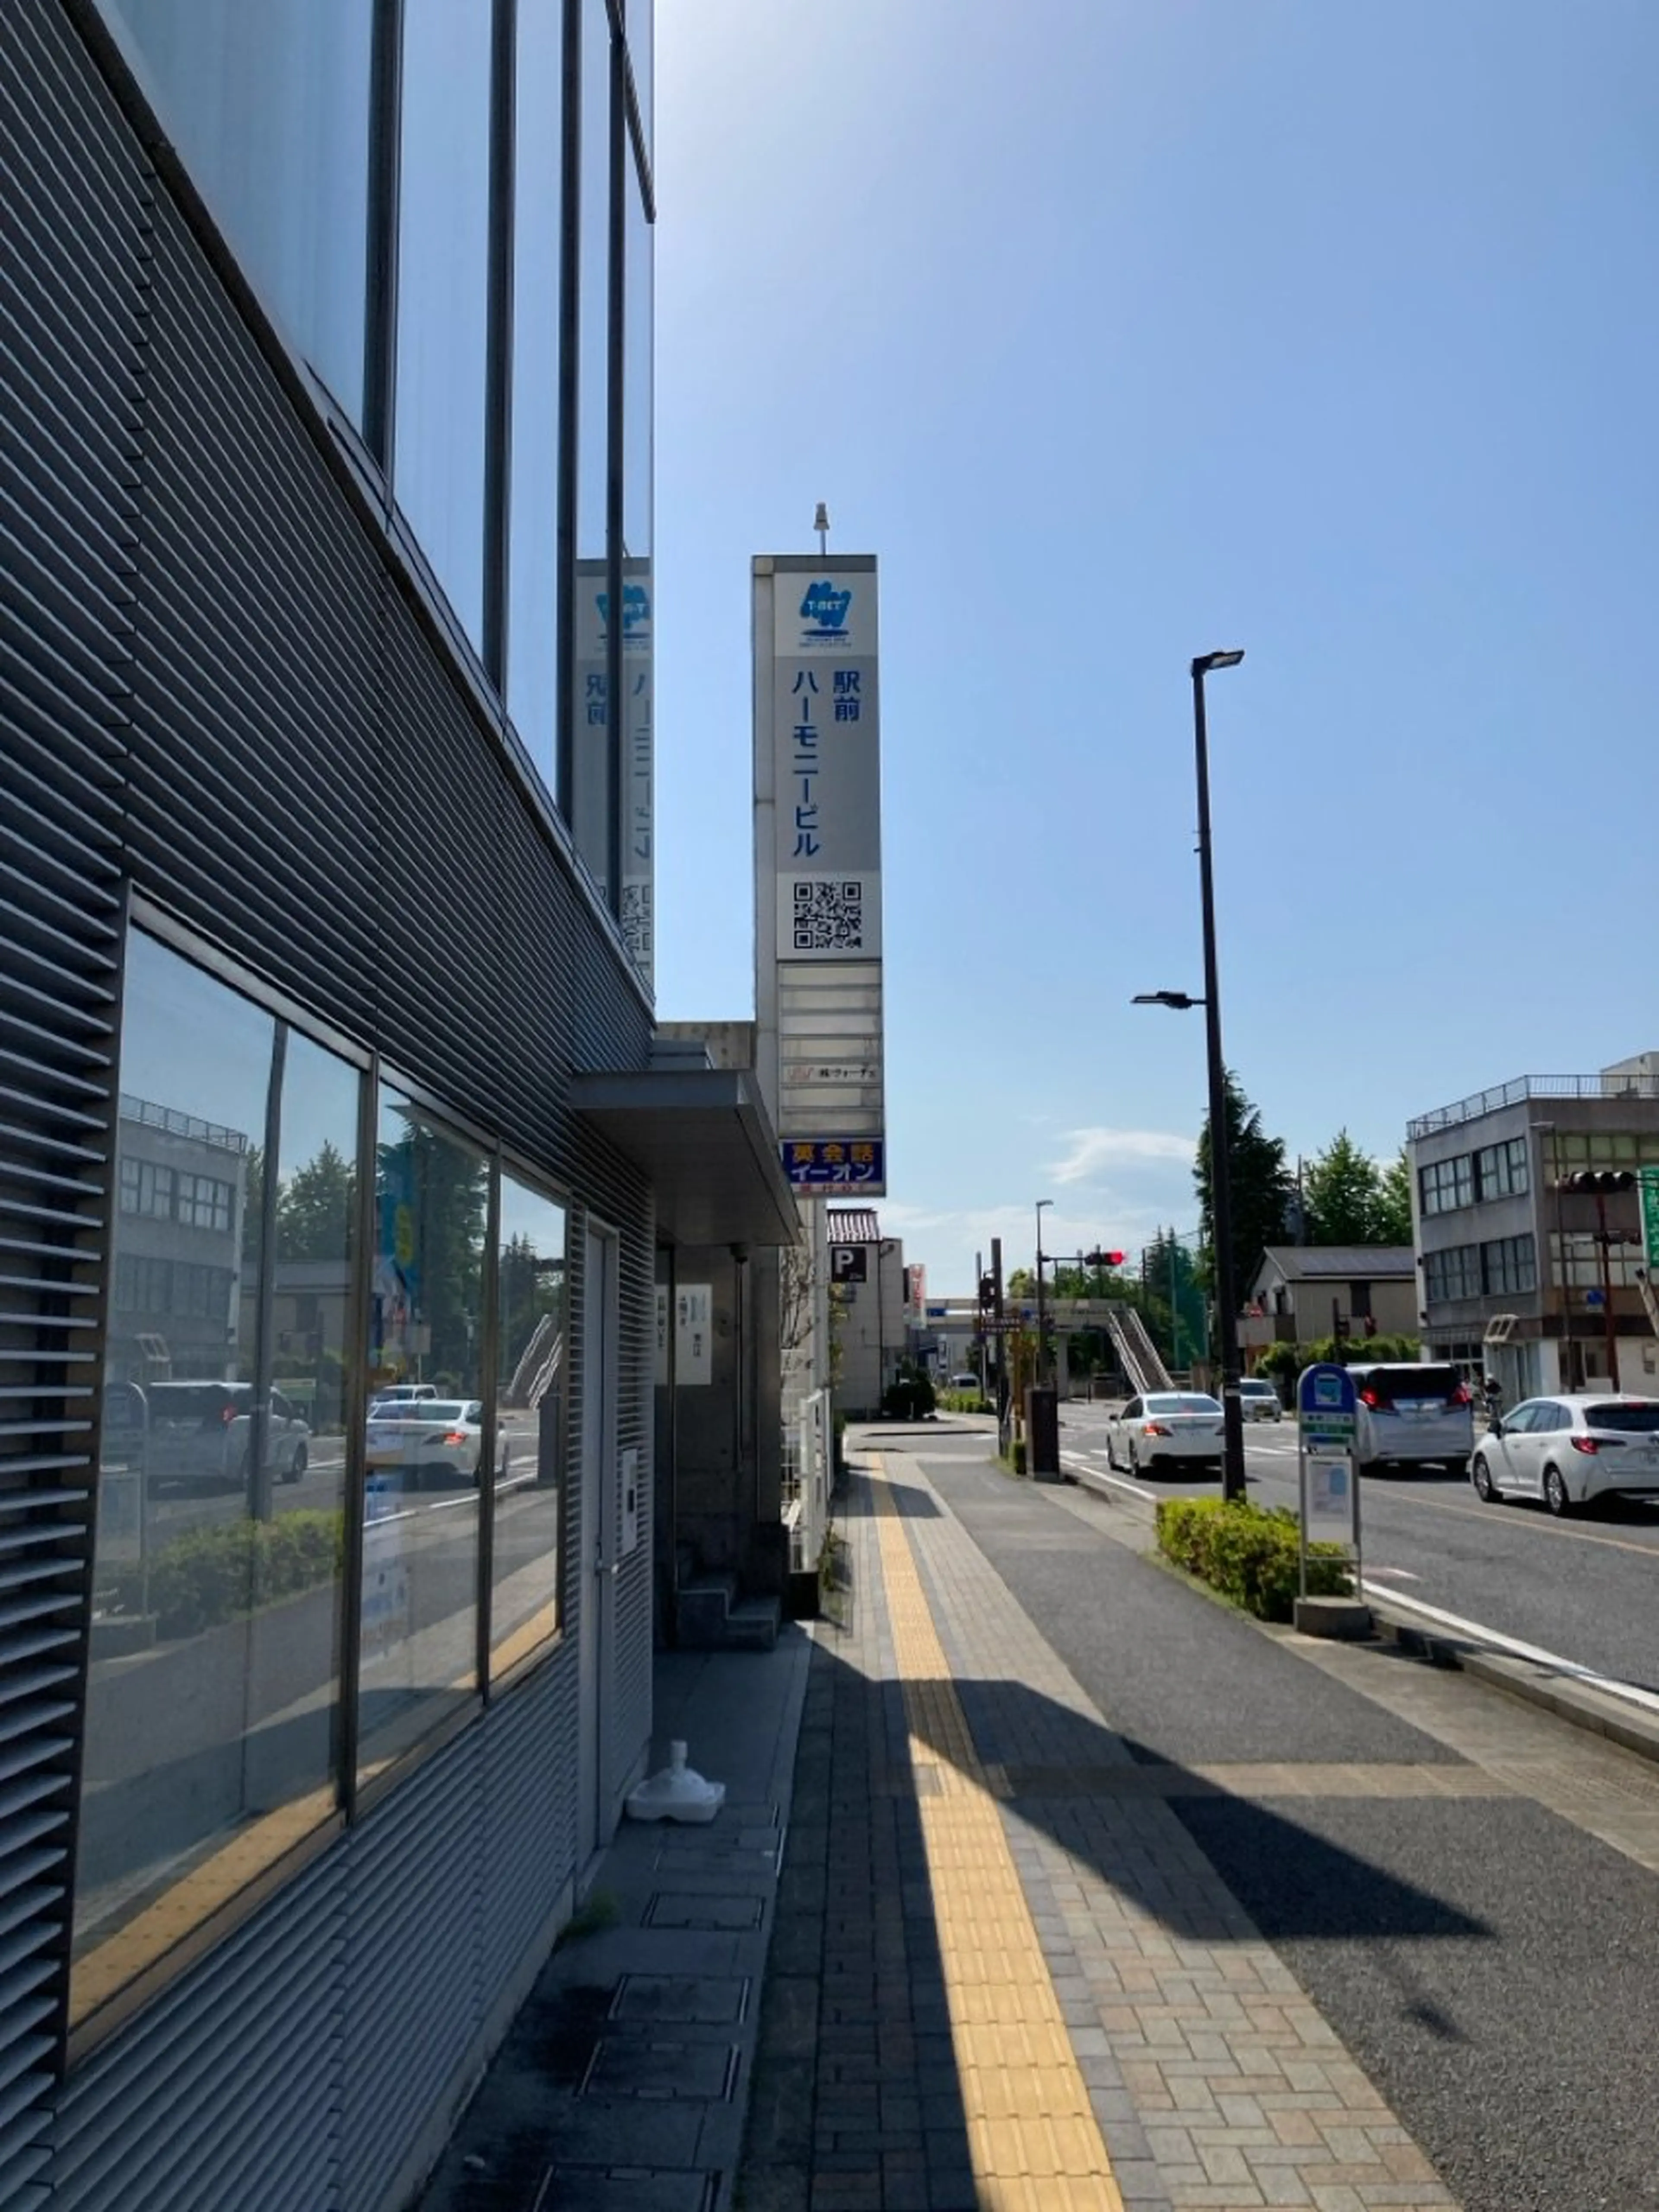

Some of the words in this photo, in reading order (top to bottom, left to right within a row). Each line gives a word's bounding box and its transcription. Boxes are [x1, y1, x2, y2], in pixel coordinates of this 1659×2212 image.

[833, 671, 861, 721] 駅前
[792, 671, 820, 857] ハーモニービル
[791, 1163, 874, 1181] イーオン
[835, 1249, 854, 1274] P
